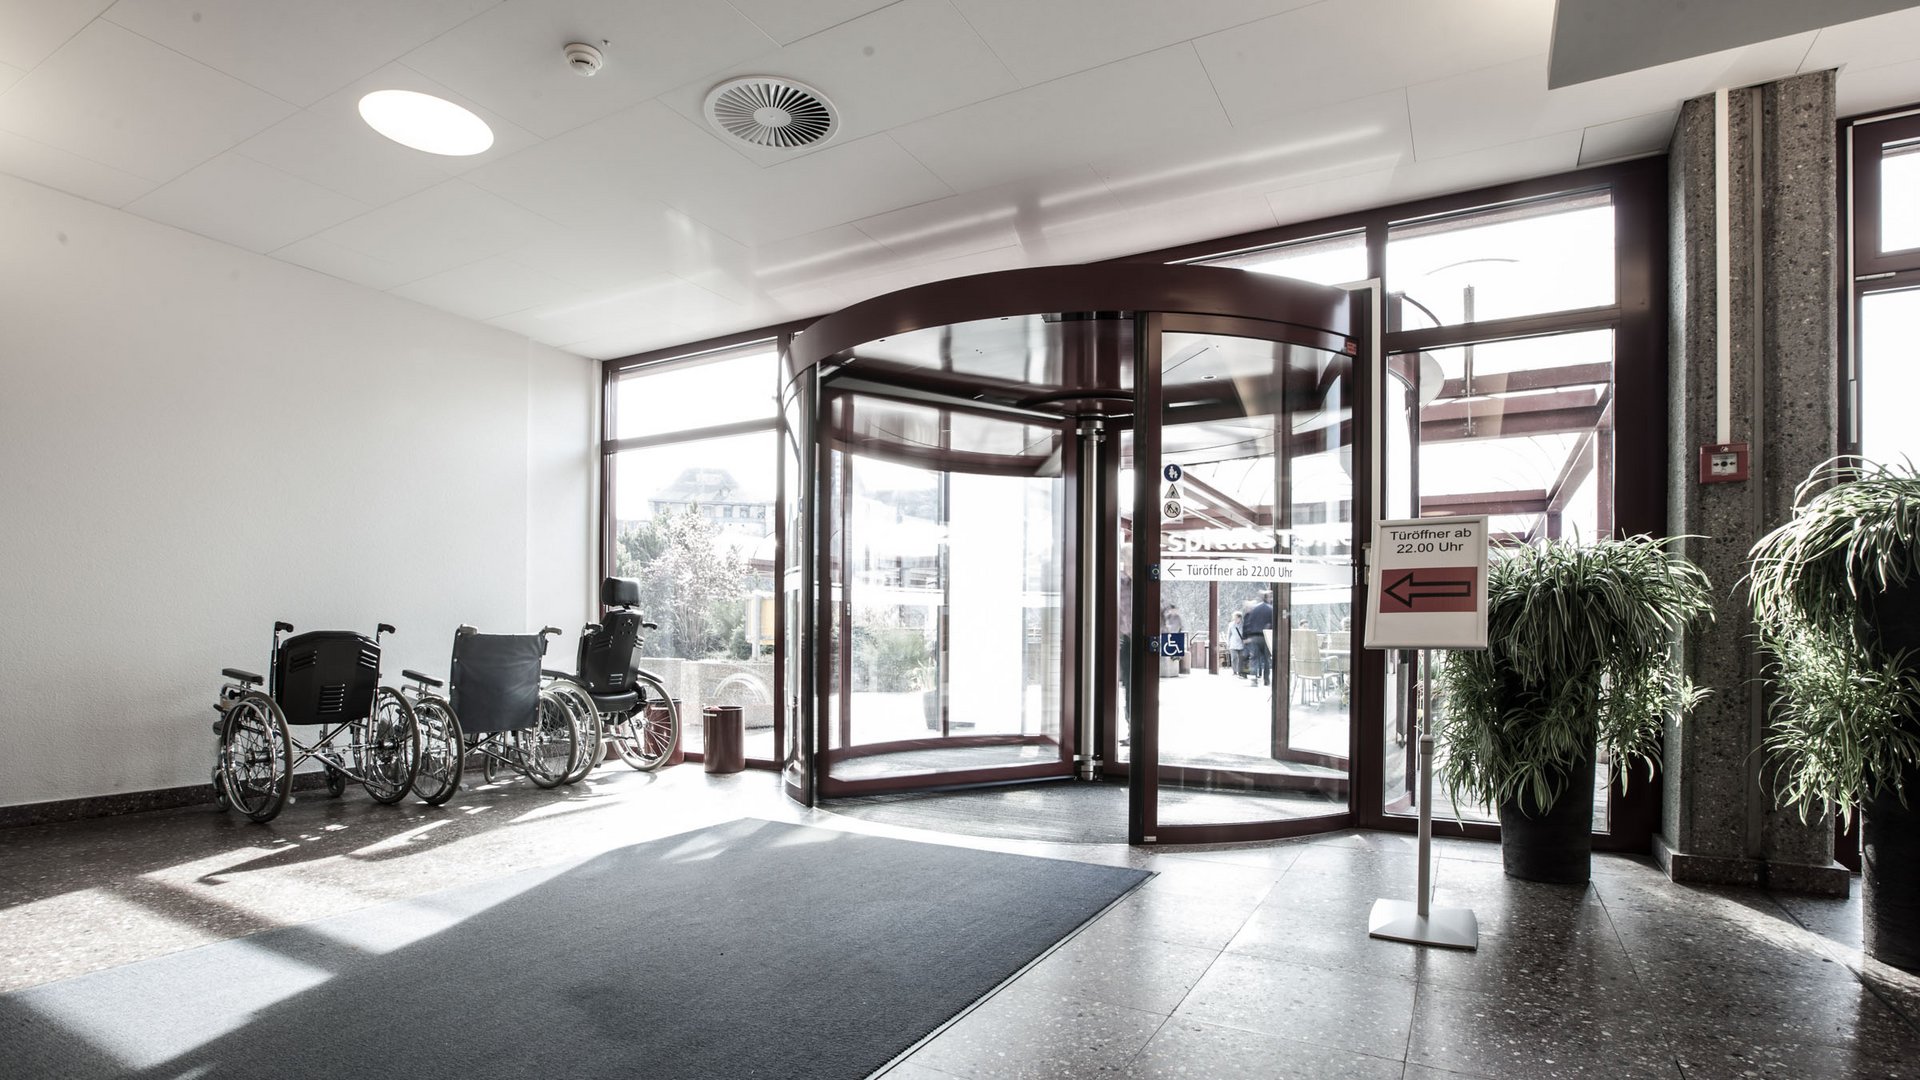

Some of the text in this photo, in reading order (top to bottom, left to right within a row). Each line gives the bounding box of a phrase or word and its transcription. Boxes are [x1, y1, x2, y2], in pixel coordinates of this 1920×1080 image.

[1390, 528, 1472, 541] Türöffner ab
[1396, 542, 1464, 554] 22.00 Uhr
[1187, 564, 1293, 578] Türöffner ab 22.00 Uhr
